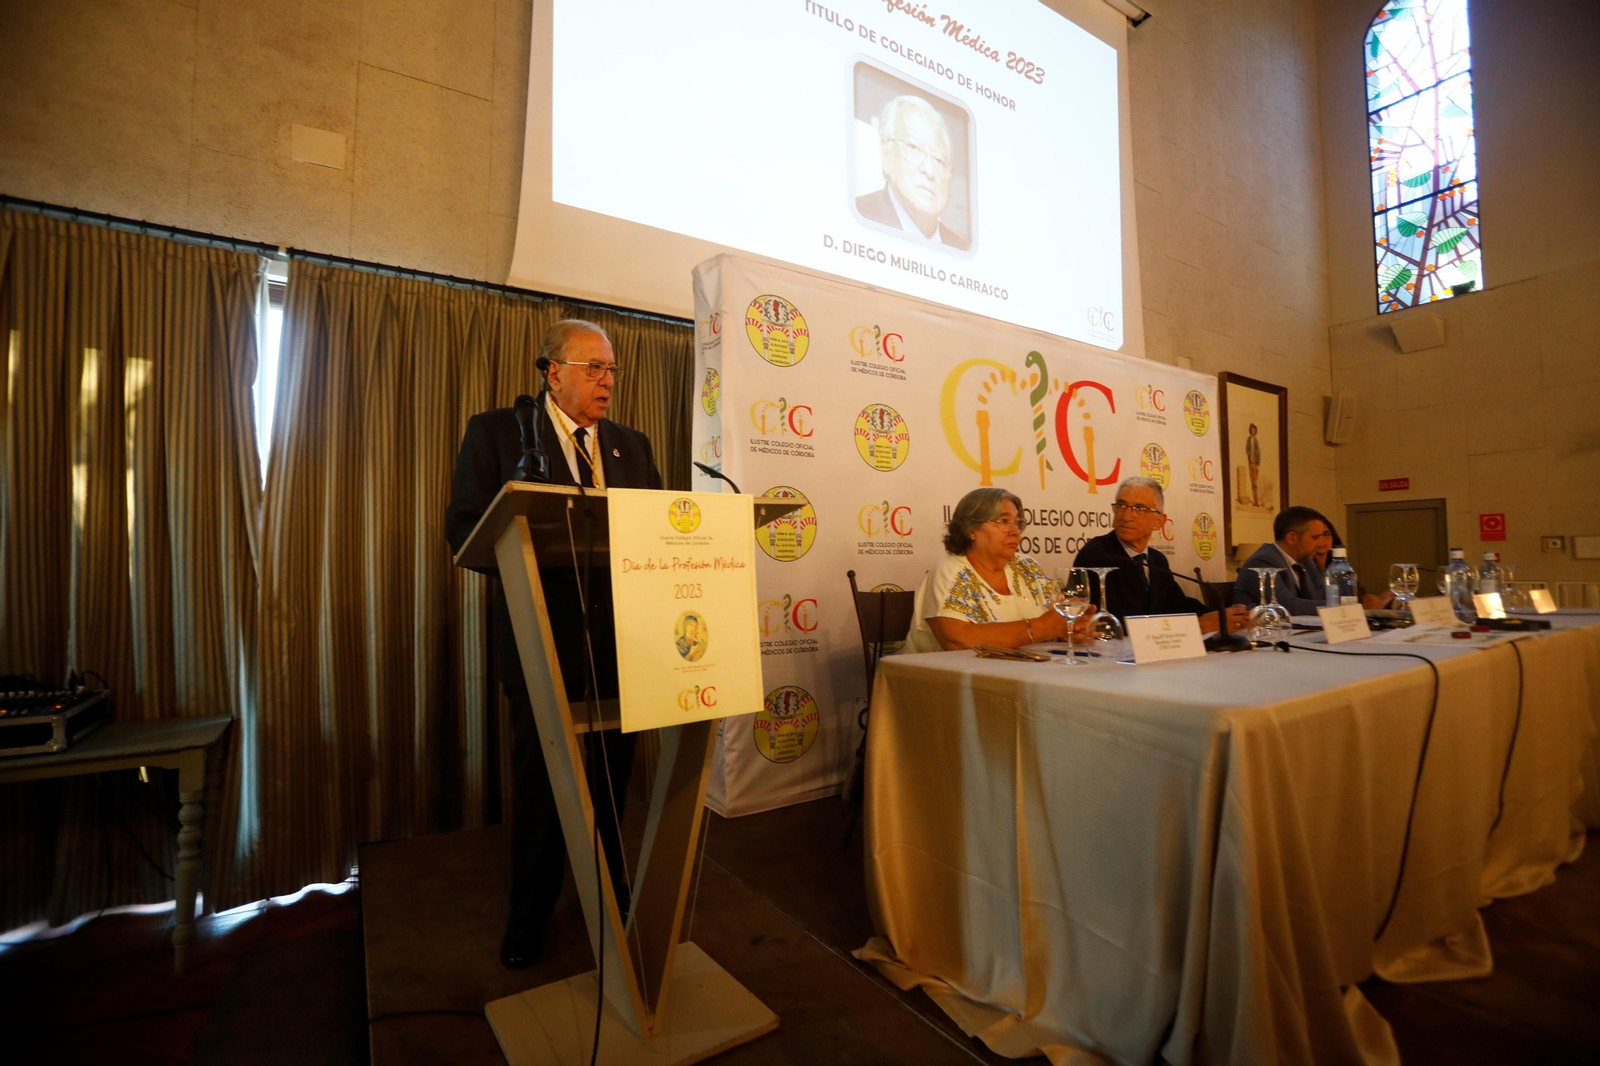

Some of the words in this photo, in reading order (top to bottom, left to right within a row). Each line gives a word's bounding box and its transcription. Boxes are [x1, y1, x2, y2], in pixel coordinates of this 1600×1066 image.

[940, 14, 1001, 63] Médica
[1005, 51, 1046, 85] 2023
[858, 24, 877, 44] DE
[880, 36, 954, 80] COLEGIADO
[957, 73, 973, 90] DE
[975, 79, 1017, 112] HONOR
[823, 234, 839, 250] D.
[842, 239, 887, 264] DIEGO
[890, 254, 947, 282] MURILLO
[950, 273, 1009, 301] CARRASCO
[750, 438, 770, 446] ILUSTRE
[771, 440, 794, 448] COLEGIO
[795, 443, 815, 451] OFICIAL
[1023, 507, 1075, 528] OLEGIO
[1078, 510, 1114, 529] OFICI
[1044, 536, 1062, 554] DE
[643, 557, 657, 572] de
[659, 557, 670, 570] la
[672, 556, 712, 572] Profesión
[713, 556, 747, 572] Médica
[674, 583, 703, 600] 2023
